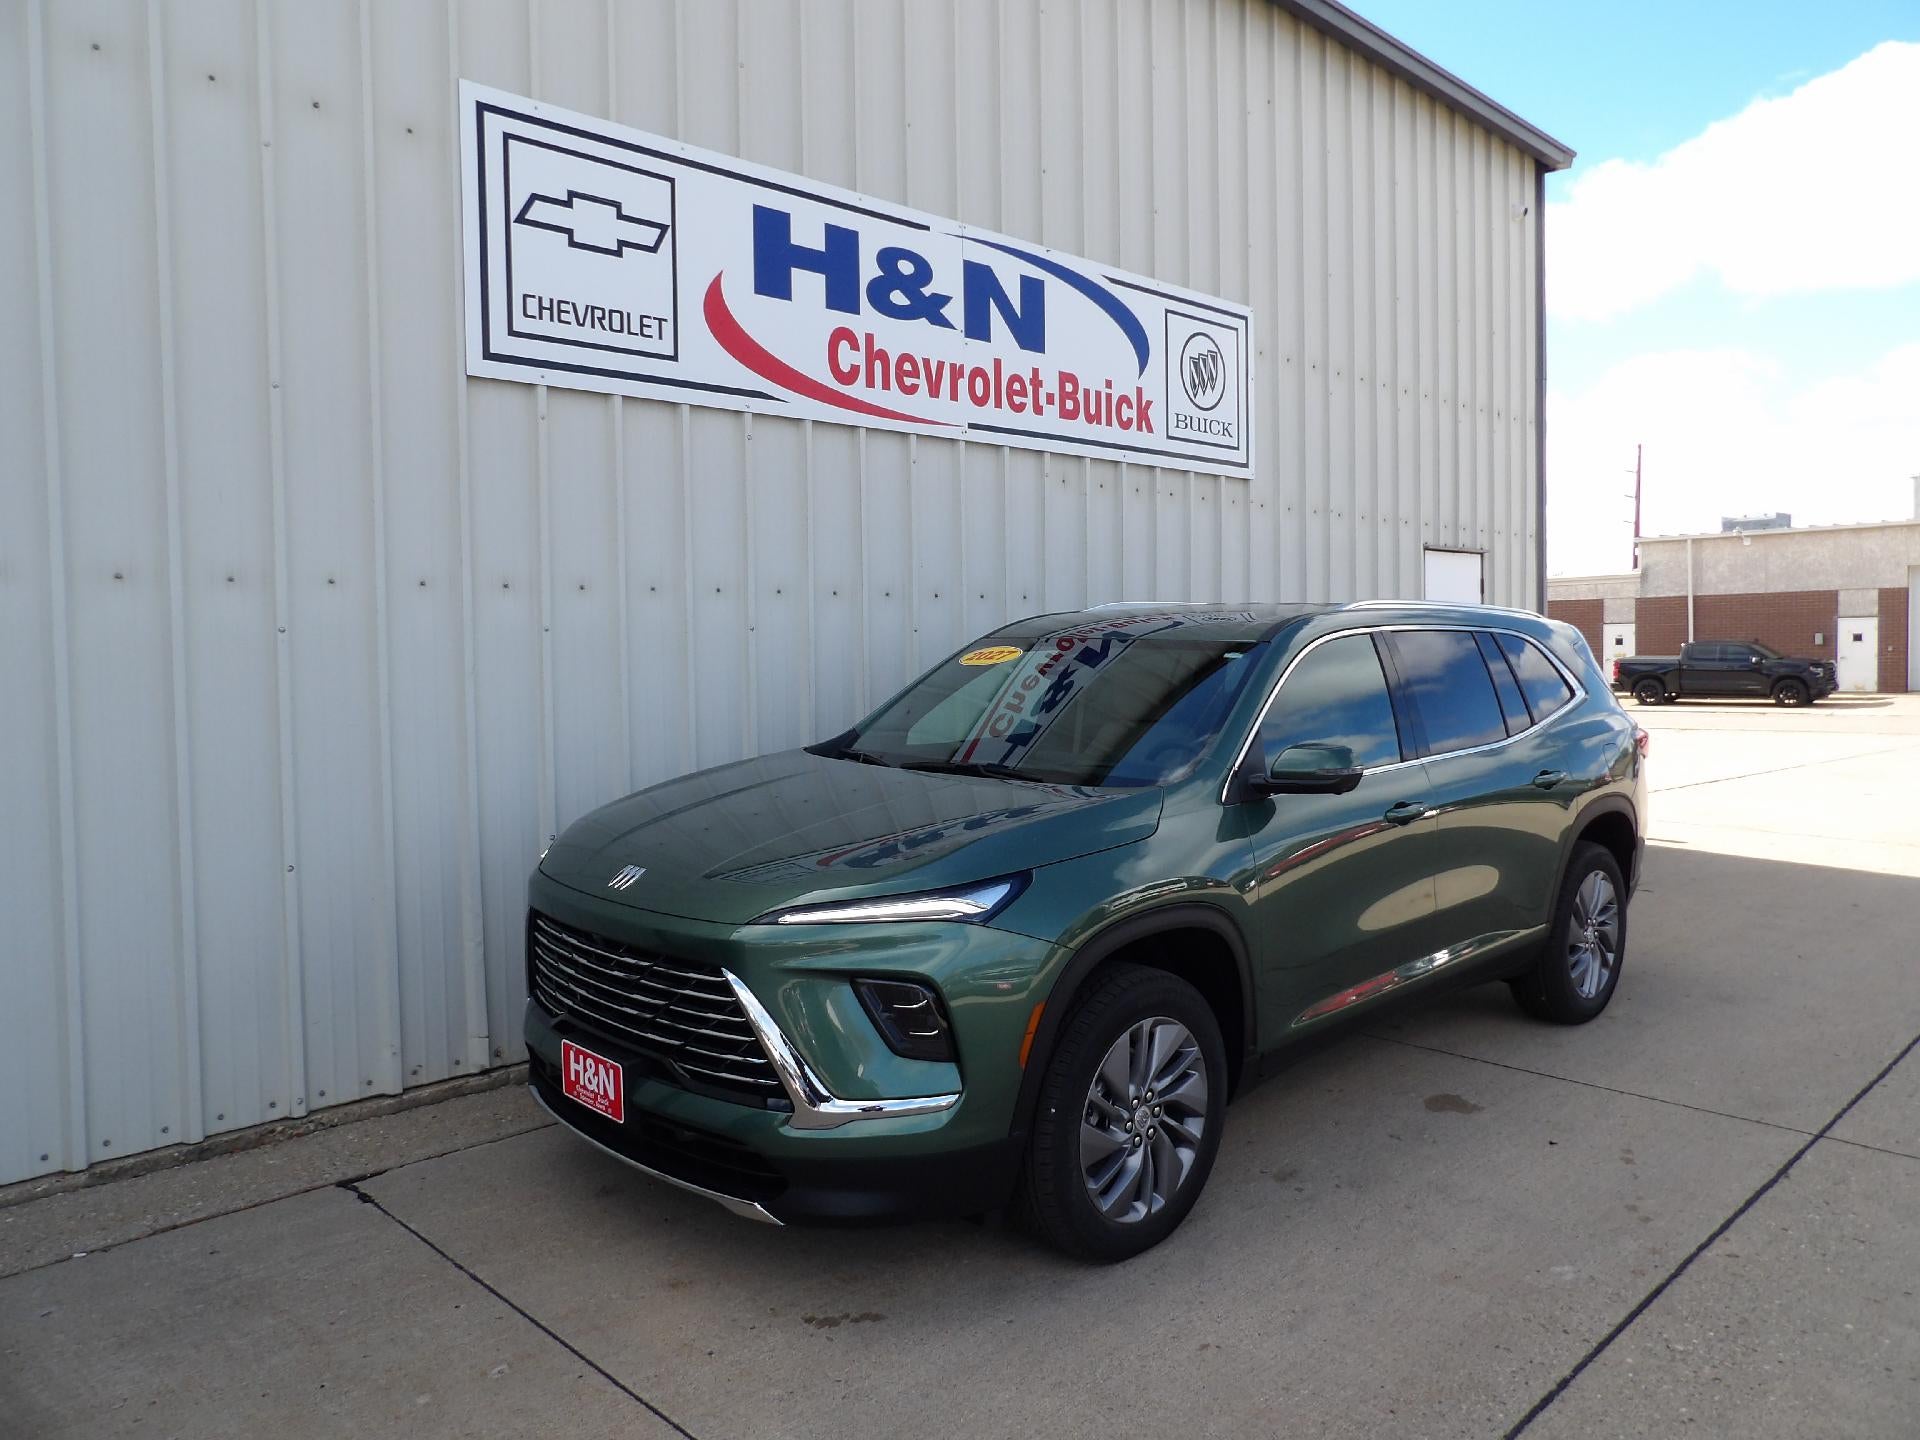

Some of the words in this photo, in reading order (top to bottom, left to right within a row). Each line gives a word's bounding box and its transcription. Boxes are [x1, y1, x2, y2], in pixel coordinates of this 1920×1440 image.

[754, 204, 1045, 353] H&N
[522, 293, 668, 341] CHEVROLET
[828, 326, 1154, 435] Chevrolet-Buick
[1174, 412, 1234, 438] BUICK
[965, 650, 1019, 662] 2027
[569, 1050, 615, 1101] H&N
